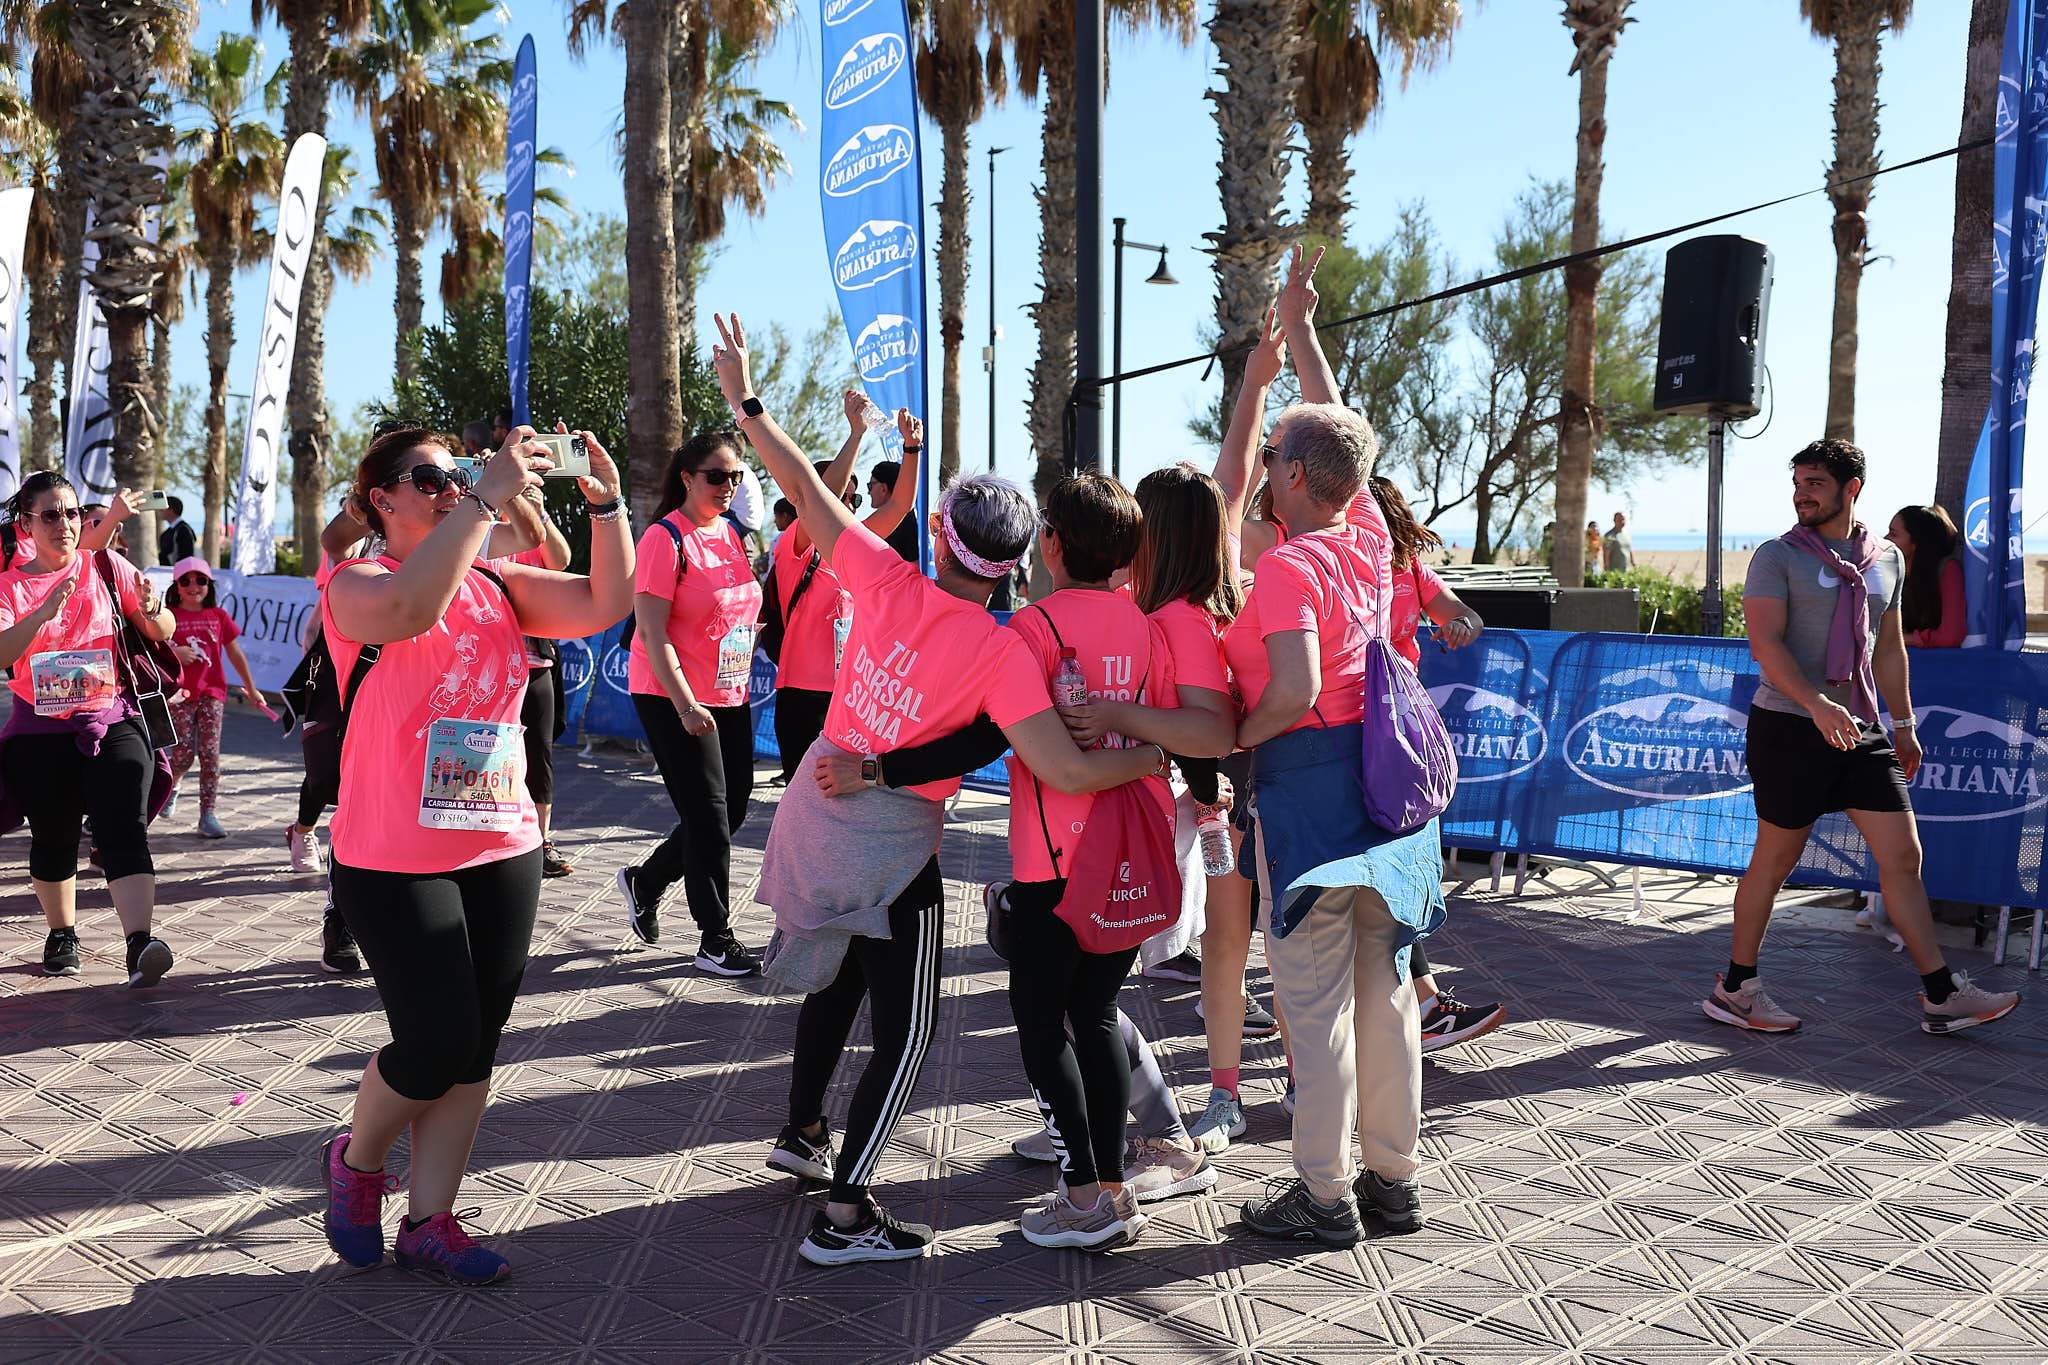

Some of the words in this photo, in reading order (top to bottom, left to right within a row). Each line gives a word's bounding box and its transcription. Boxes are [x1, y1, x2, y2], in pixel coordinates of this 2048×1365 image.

[248, 185, 308, 493] OYSHO
[883, 640, 918, 678] TU
[1102, 655, 1132, 686] TU
[853, 644, 924, 723] DORSAL
[844, 680, 902, 746] SUMA
[1467, 718, 1528, 731] LECHERA
[1450, 732, 1531, 761] RIANA
[1576, 727, 1748, 776] ASTURIAN
[1950, 745, 2036, 761] LECHERA
[464, 769, 501, 789] 016
[1919, 762, 2041, 796] RIANA
[428, 799, 457, 809] CARRERA
[470, 792, 491, 801] 5409
